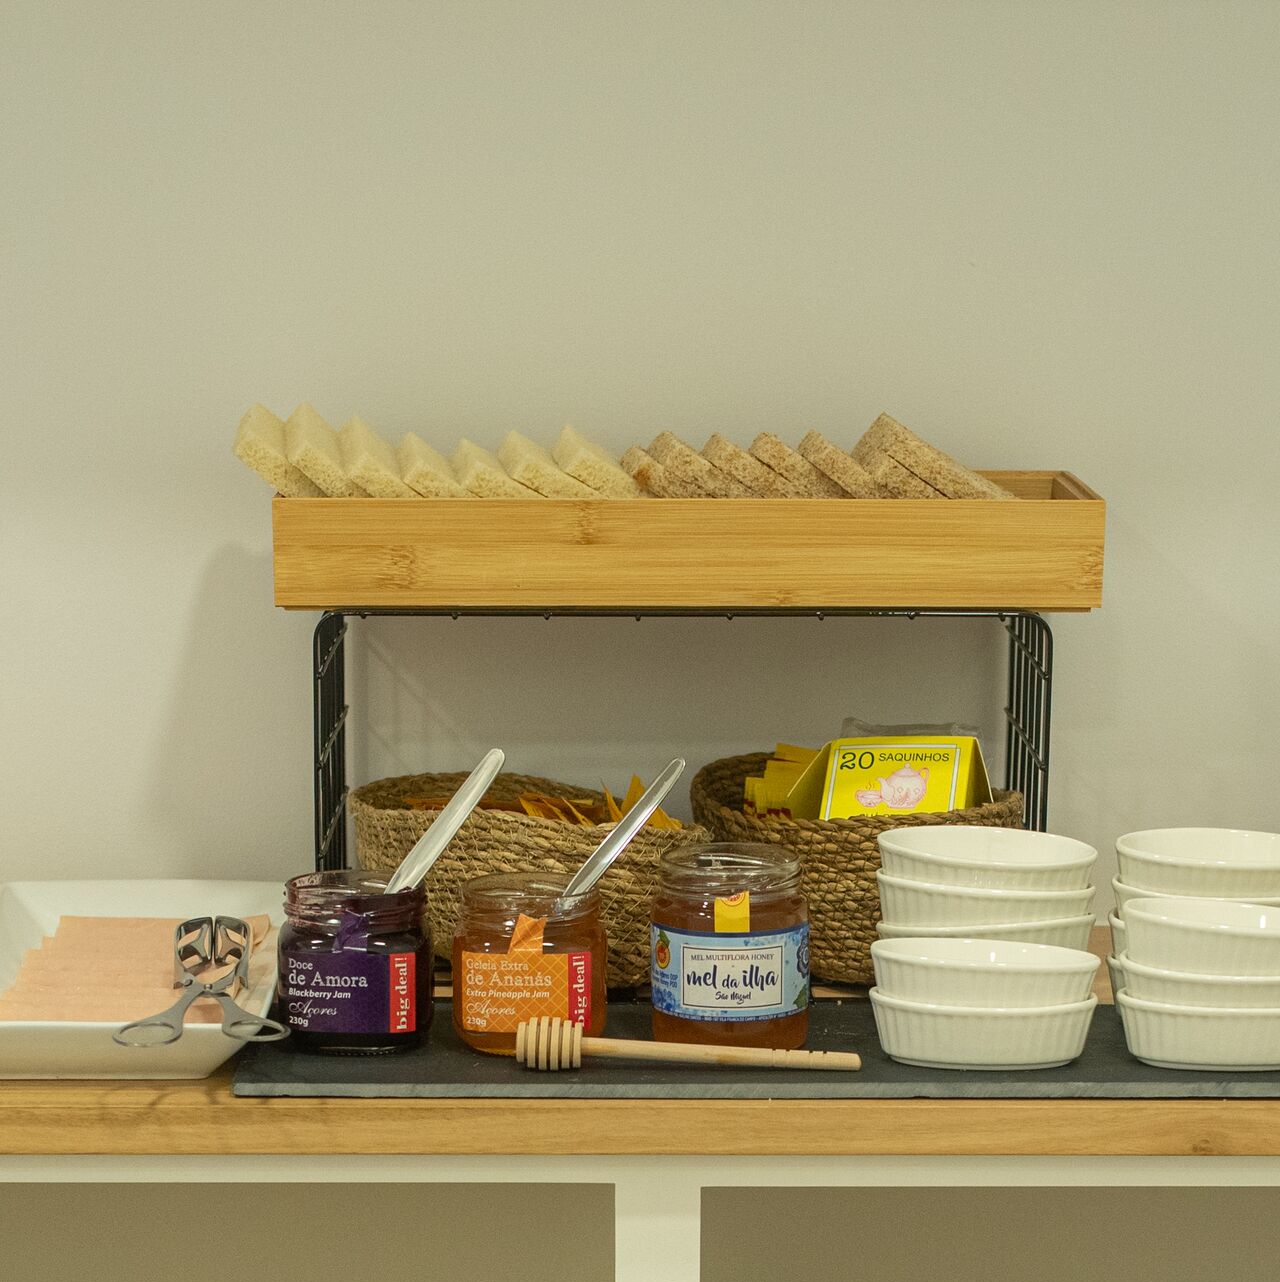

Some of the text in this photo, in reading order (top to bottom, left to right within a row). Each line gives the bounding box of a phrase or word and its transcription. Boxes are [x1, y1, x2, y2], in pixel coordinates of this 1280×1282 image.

[840, 751, 950, 770] 20 SAQUINHOS
[288, 957, 314, 970] Doce
[466, 958, 529, 971] Geleia Extra
[751, 953, 775, 961] HONEY
[288, 969, 369, 988] de Amora
[466, 969, 553, 987] de Ananás
[572, 955, 585, 993] deal!
[686, 964, 718, 990] mel
[721, 974, 740, 989] da
[742, 963, 779, 991] ilha
[288, 987, 352, 1000] Blackberry Jam
[394, 957, 410, 1030] big deal!
[466, 988, 550, 999] Extra Pineapple Jam
[288, 999, 338, 1018] Açores
[466, 999, 516, 1018] Açores
[289, 1016, 309, 1028] 230g
[467, 1016, 487, 1028] 230g
